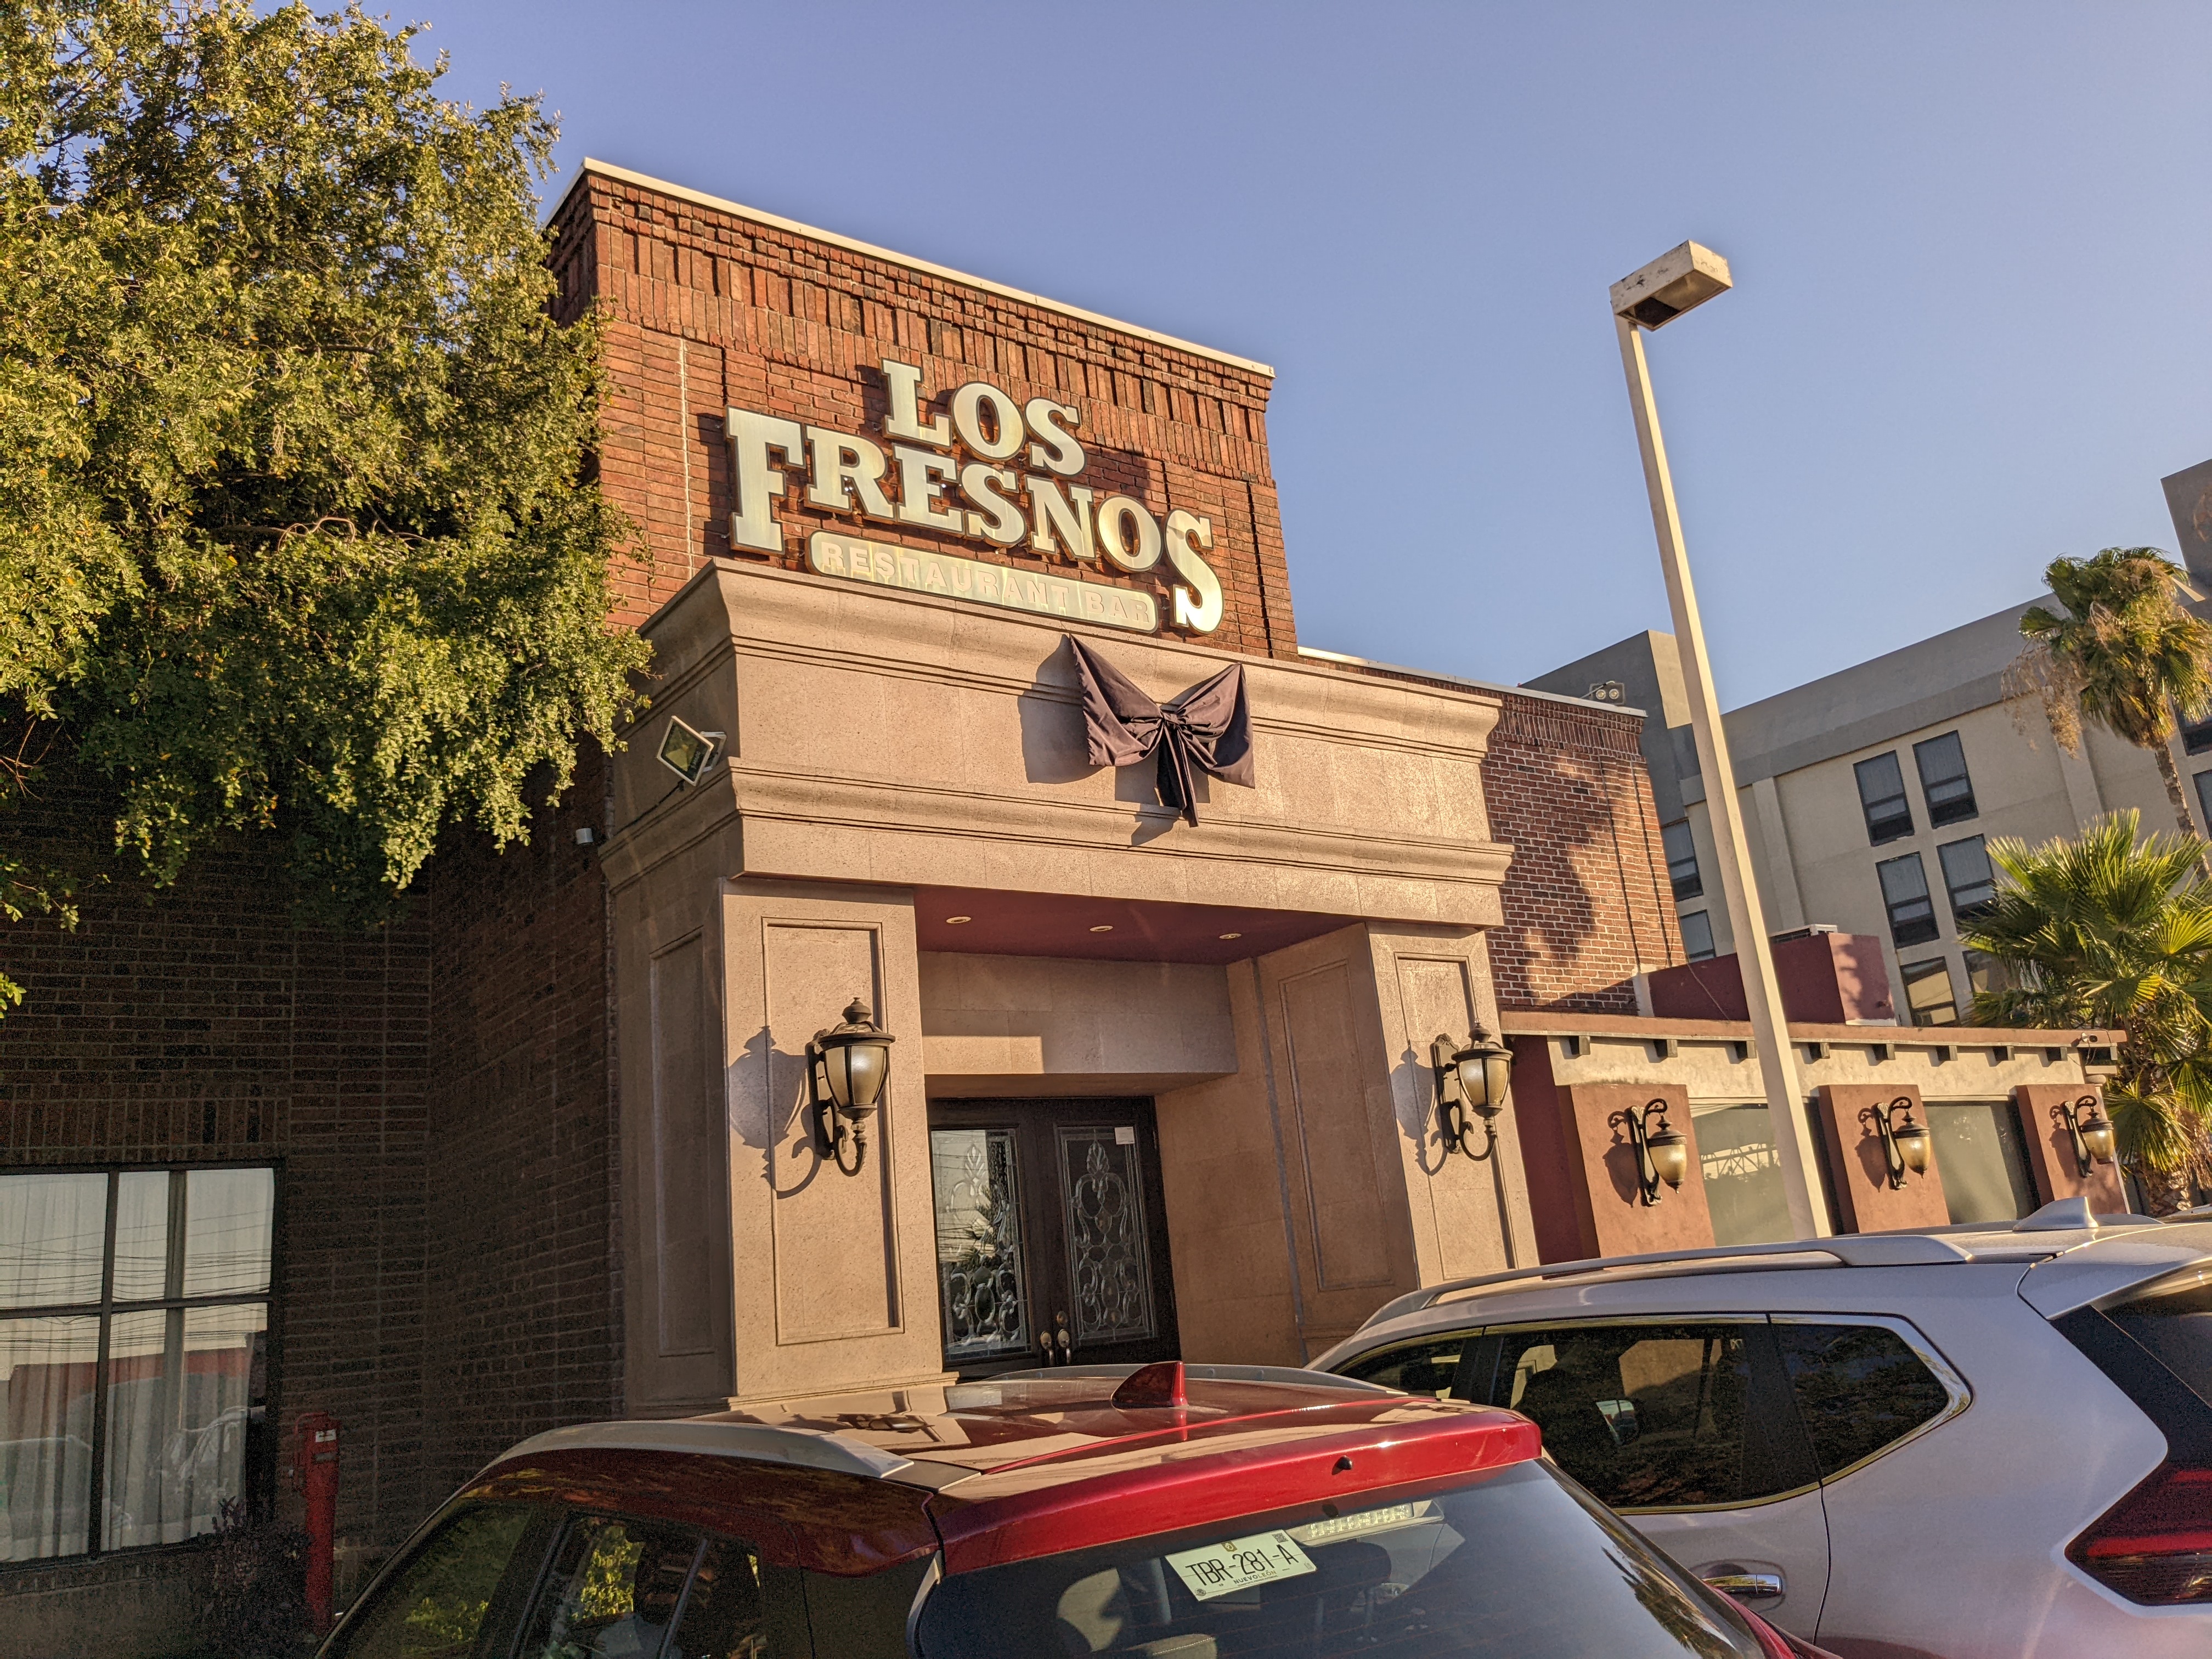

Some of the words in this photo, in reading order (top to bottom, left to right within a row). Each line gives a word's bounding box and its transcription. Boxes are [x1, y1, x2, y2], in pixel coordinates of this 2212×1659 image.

[882, 359, 1087, 477] LOS
[725, 405, 1225, 635] FRESNOS
[821, 542, 1069, 610] RESTAURANT
[1086, 590, 1150, 623] BAR
[1185, 1544, 1299, 1586] TBR-281-A
